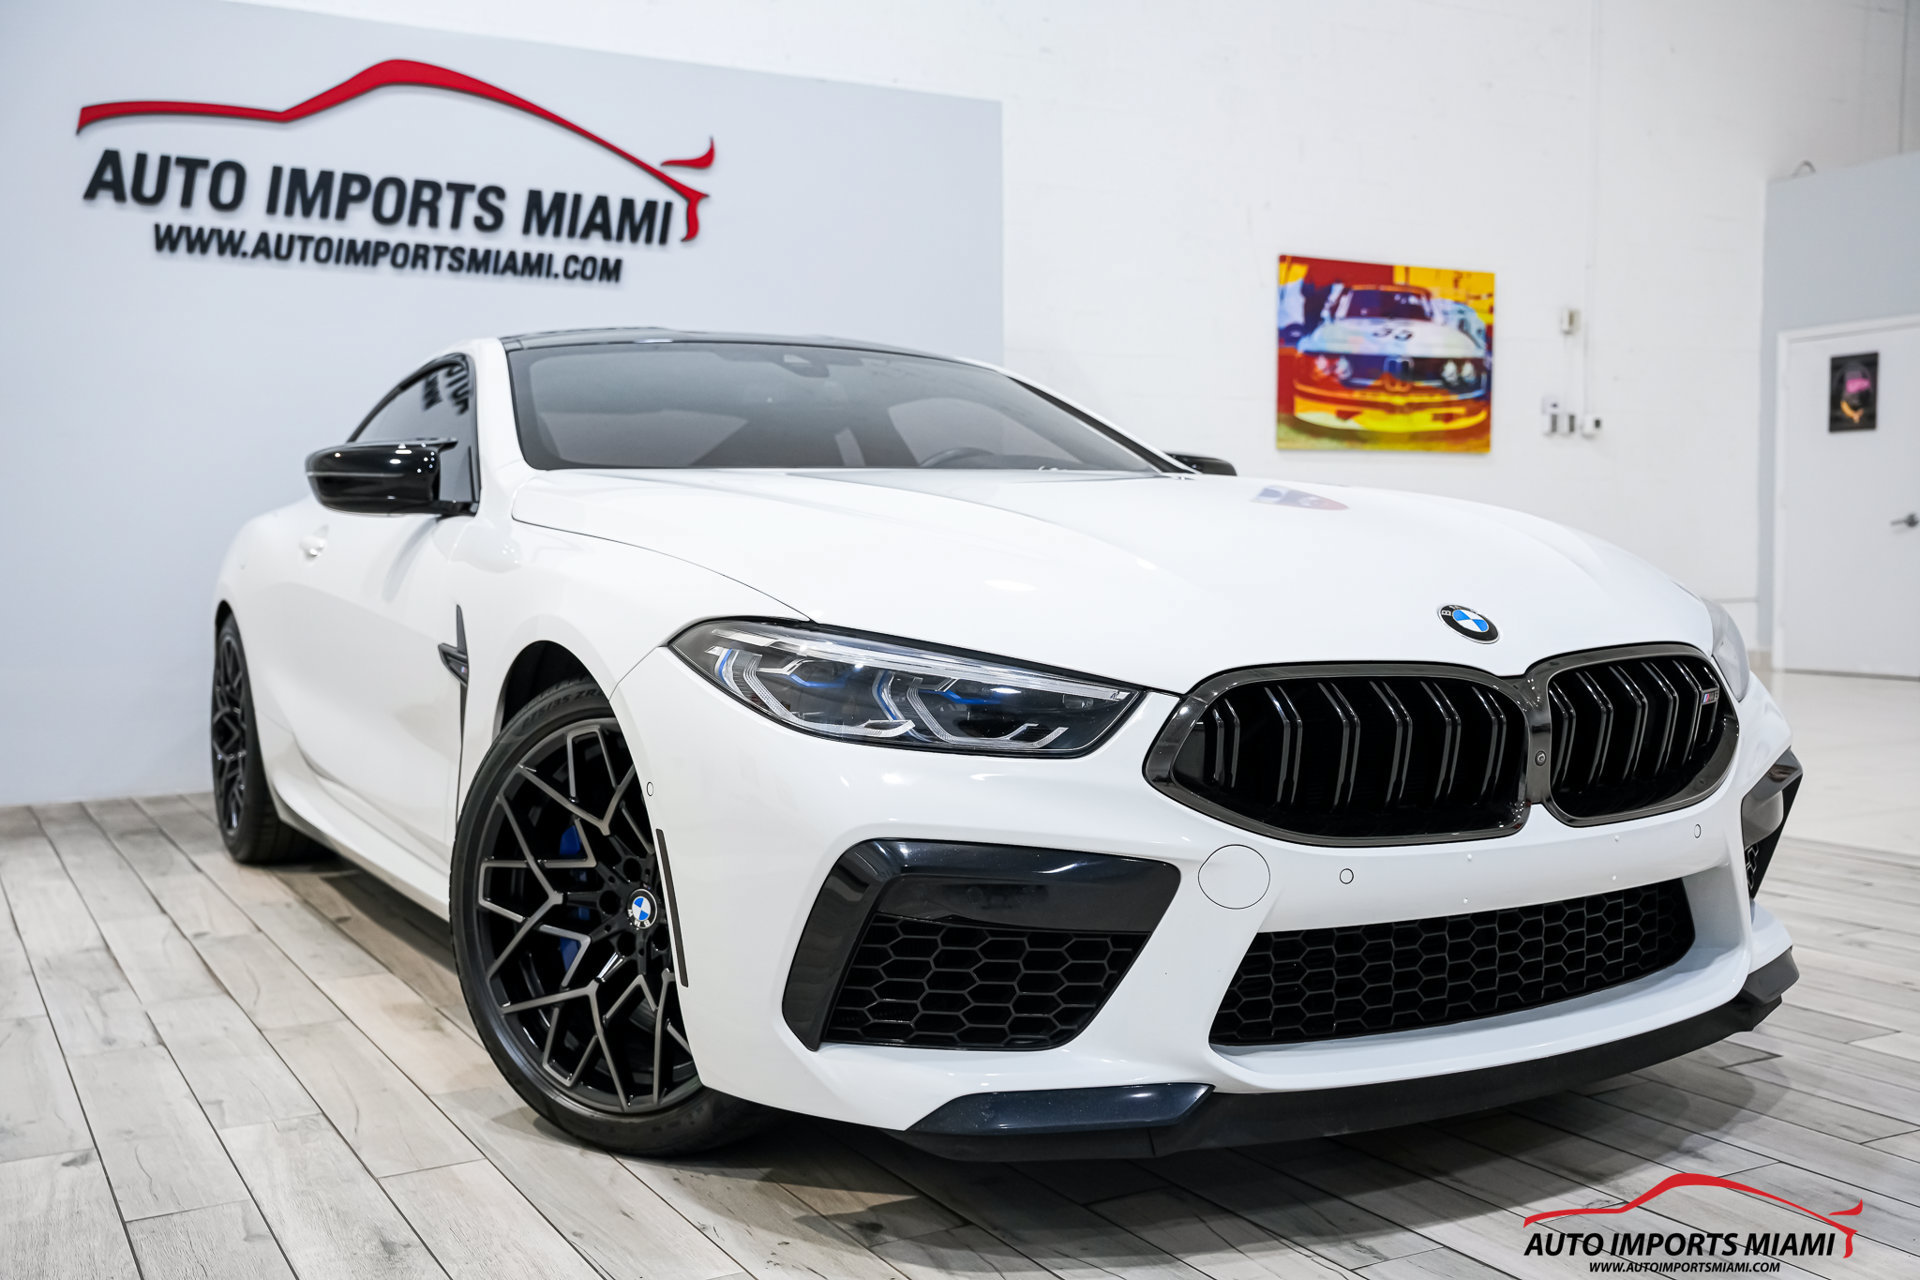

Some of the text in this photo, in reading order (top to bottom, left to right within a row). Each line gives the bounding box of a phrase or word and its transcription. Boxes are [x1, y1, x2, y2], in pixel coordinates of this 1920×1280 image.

[83, 149, 673, 246] AUTO IMPORTS MIAMI
[154, 223, 622, 283] WWW.AUTOIMPORTSMIAMI.COM
